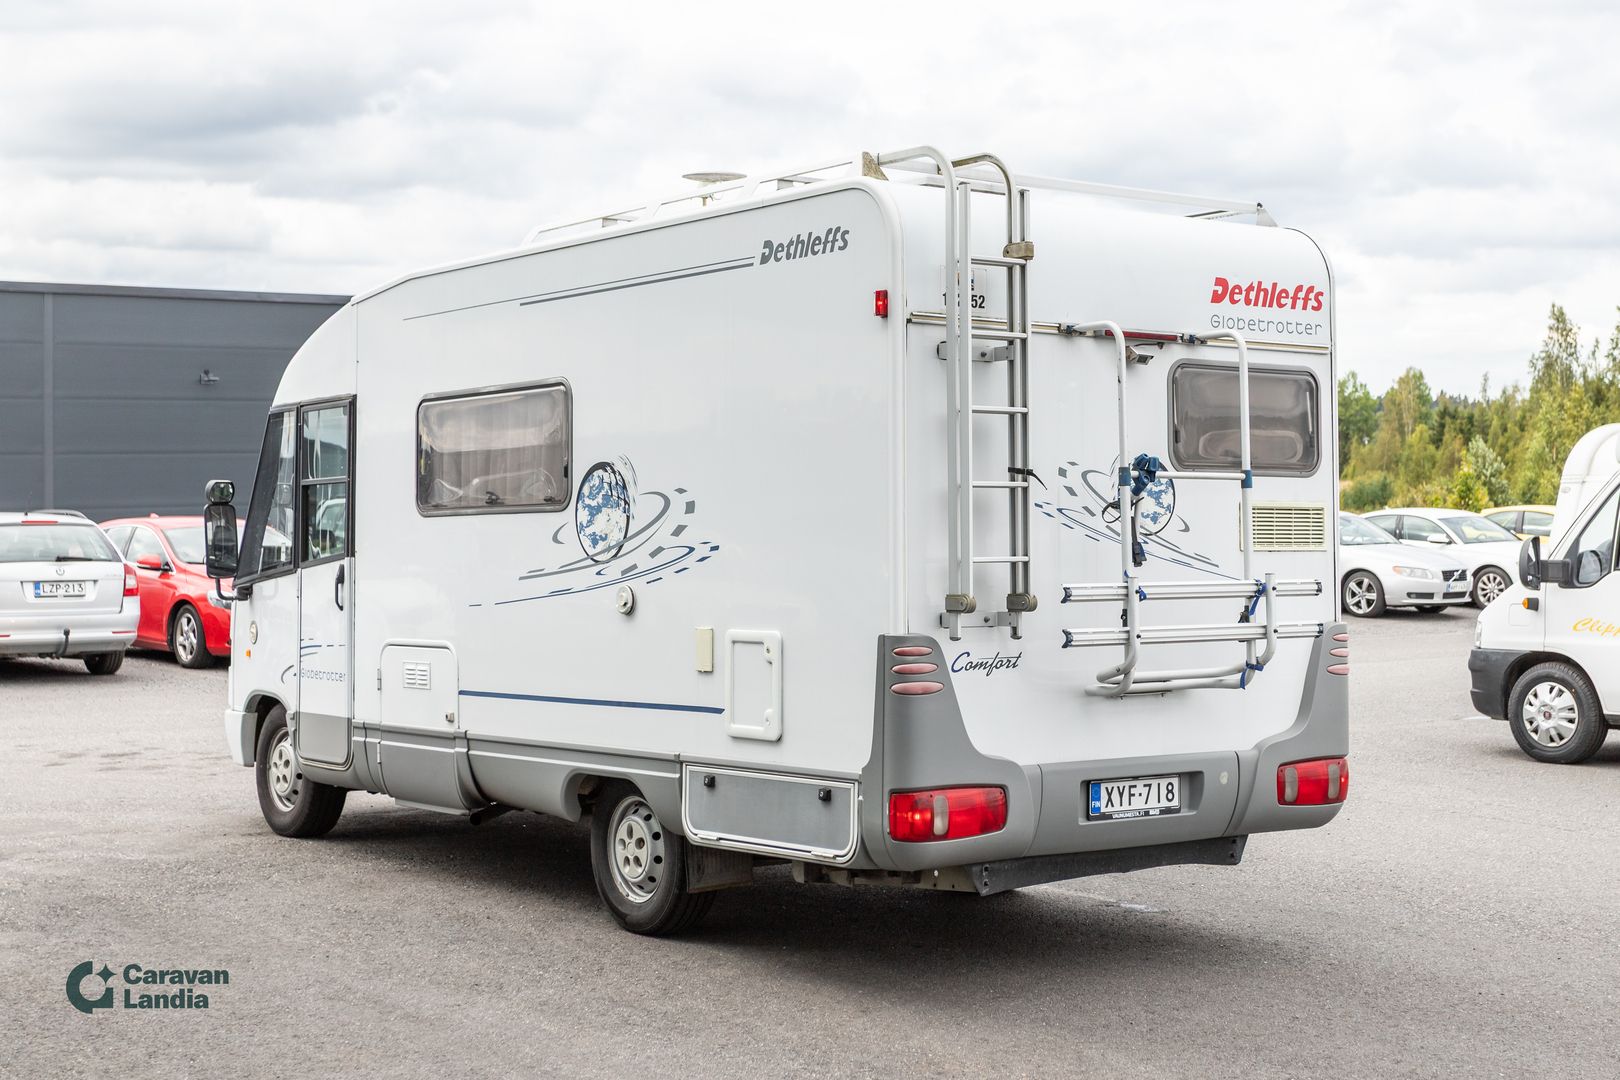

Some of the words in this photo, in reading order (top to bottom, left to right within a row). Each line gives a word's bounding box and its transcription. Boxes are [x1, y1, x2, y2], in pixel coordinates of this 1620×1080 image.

[759, 225, 850, 266] Dethleffs
[1210, 276, 1324, 312] Dethleffs
[1210, 314, 1323, 336] Globetrotter
[42, 583, 84, 593] LZP-213
[950, 651, 1023, 677] Comfort
[1104, 781, 1175, 809] XYF-718
